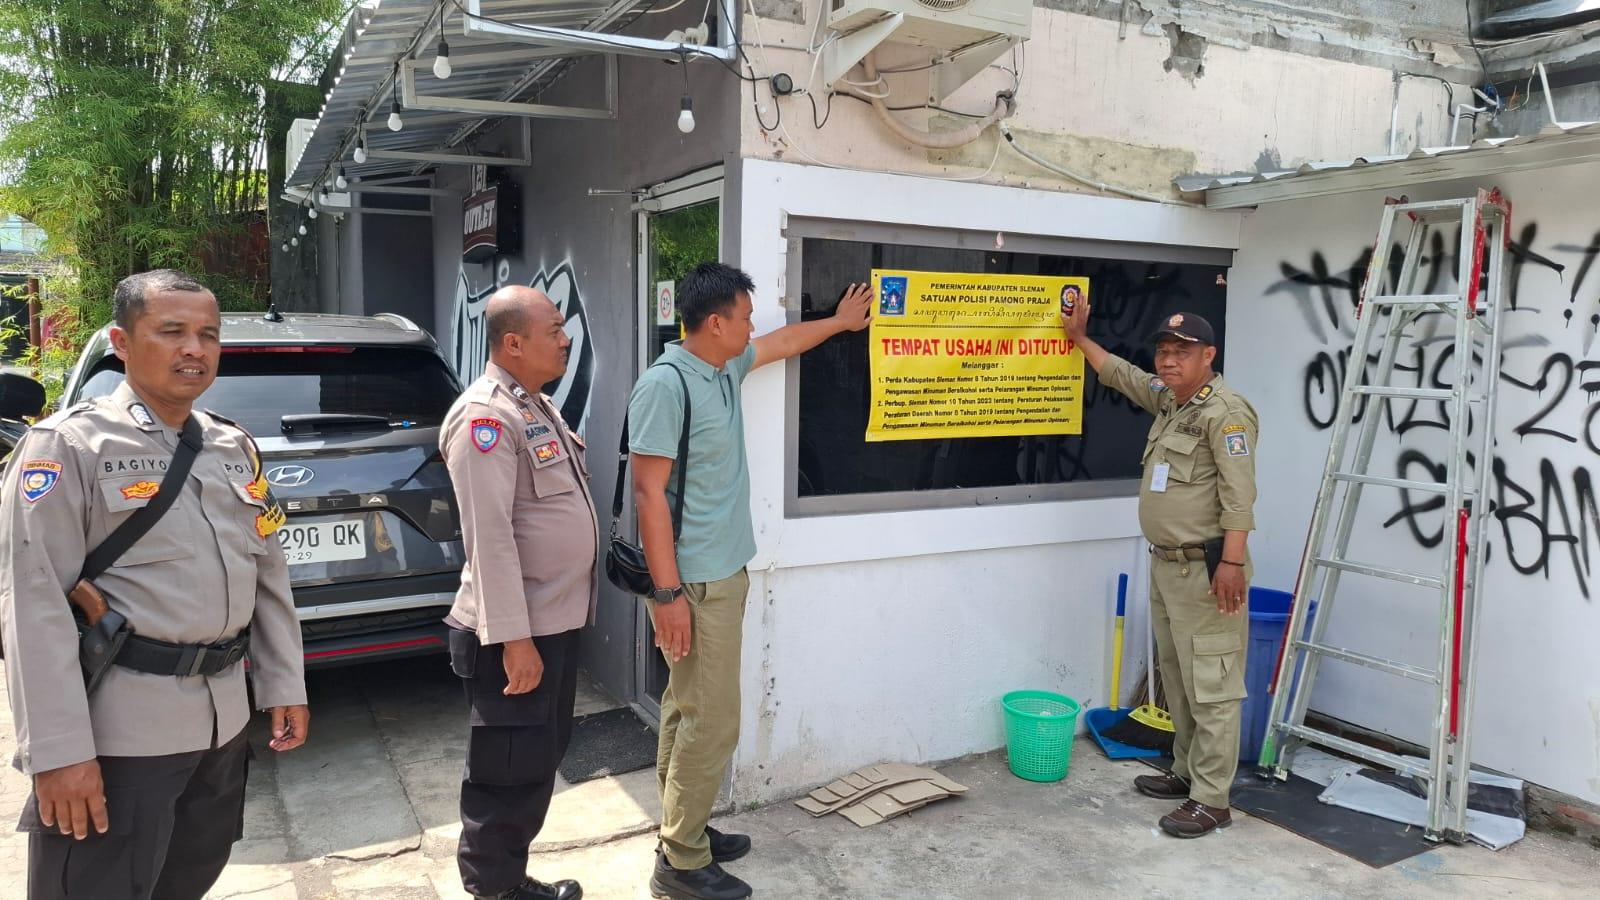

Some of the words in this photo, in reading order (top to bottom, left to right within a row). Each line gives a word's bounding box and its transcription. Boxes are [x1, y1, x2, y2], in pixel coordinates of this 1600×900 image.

[464, 200, 496, 235] OUTLET
[977, 284, 1018, 292] KABUPATEN
[1019, 285, 1045, 293] SLEMAN
[920, 294, 956, 302] SATUAN
[959, 295, 987, 303] POLISI
[989, 296, 1025, 304] PAMONG
[1027, 297, 1051, 305] PRAJA
[882, 338, 940, 356] TEMPAT
[945, 338, 992, 356] USAHA
[995, 338, 1013, 355] INI
[1019, 338, 1074, 356] DITUTUP
[961, 362, 999, 370] Melanggar
[903, 376, 935, 384] Kabupaten
[1037, 374, 1070, 382] Pengendalian
[885, 388, 921, 396] Pengawasan
[993, 396, 1014, 404] tentang
[1016, 395, 1042, 403] Peraturan
[1016, 407, 1050, 415] Pengendalian
[992, 418, 1023, 426] Pelarangan
[104, 459, 167, 473] BAGIYO
[333, 523, 361, 546] QK
